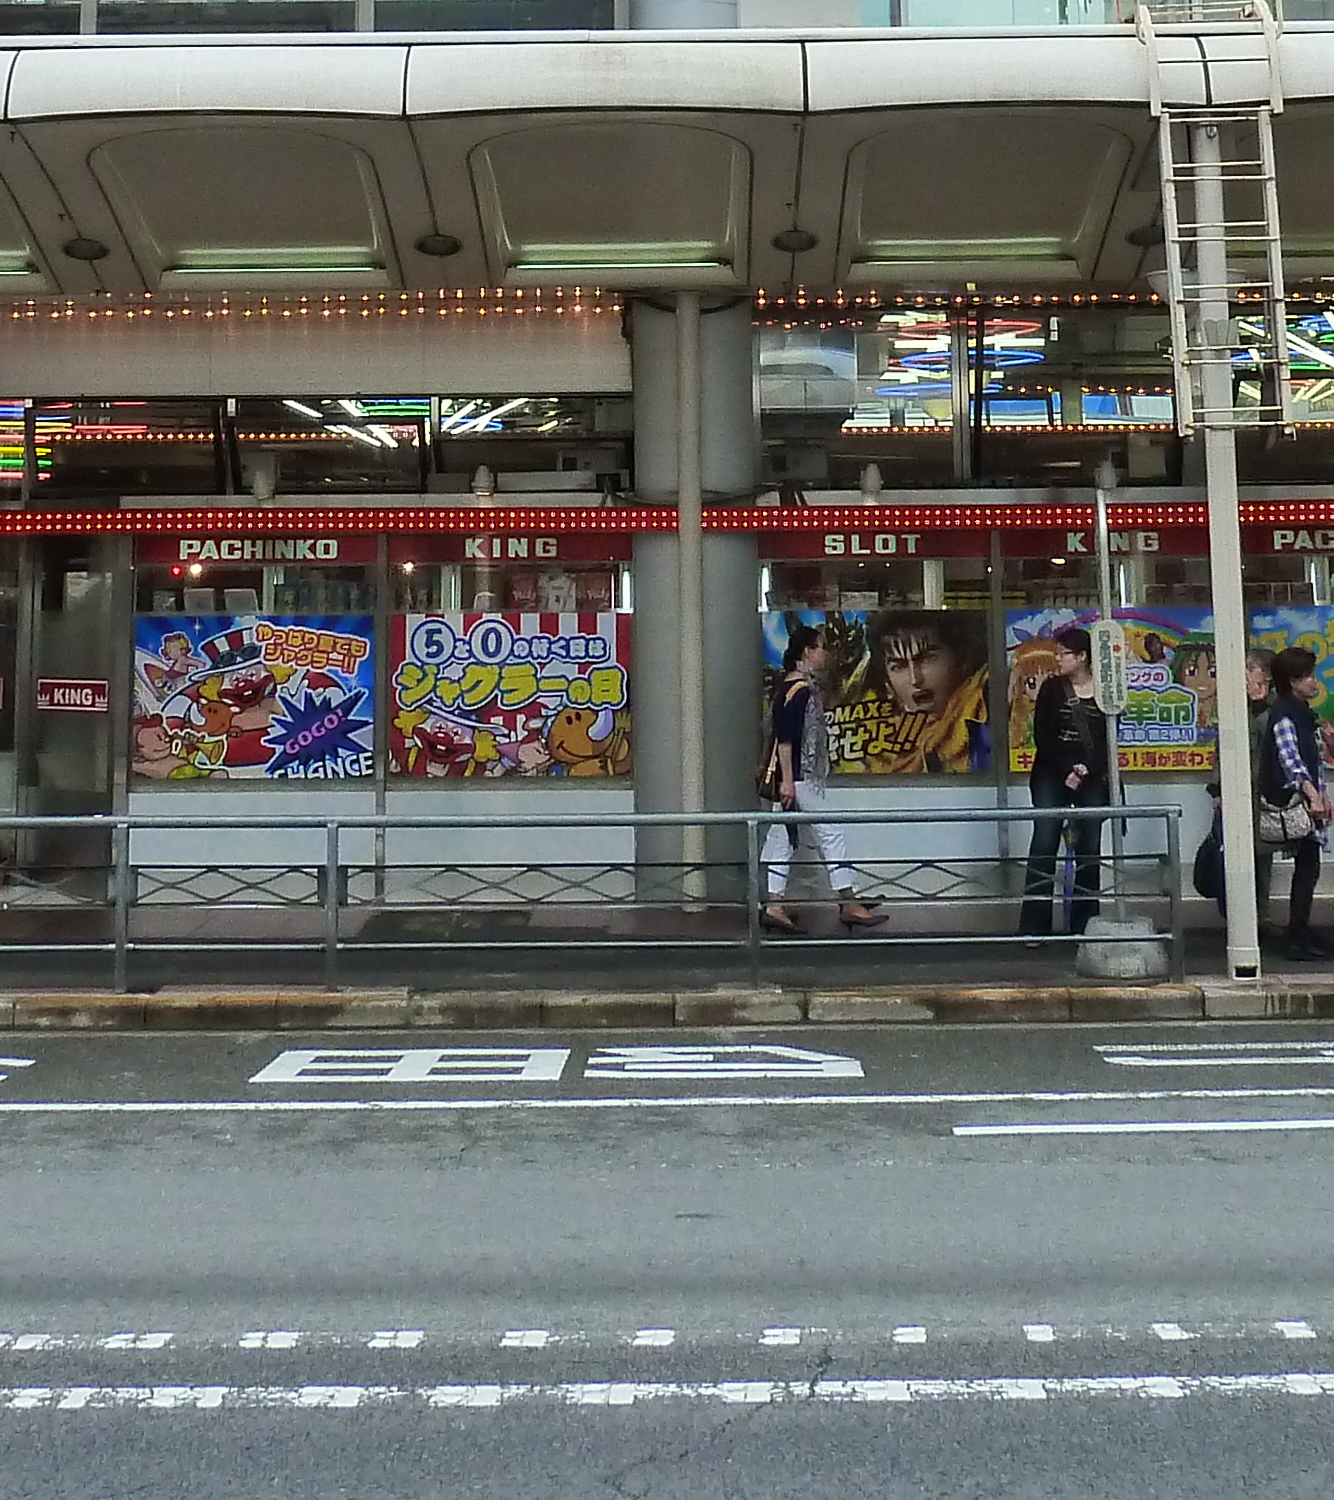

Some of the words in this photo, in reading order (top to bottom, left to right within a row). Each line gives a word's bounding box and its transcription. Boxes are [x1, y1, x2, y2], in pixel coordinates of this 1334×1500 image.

[179, 539, 338, 560] PACHINKO
[465, 537, 558, 558] KING
[824, 534, 922, 555] SLOT
[1067, 532, 1159, 552] KNG
[395, 664, 626, 707] ジャグラーの日
[1125, 672, 1165, 683] ングの
[53, 688, 92, 706] KING
[284, 708, 347, 755] GOGO!
